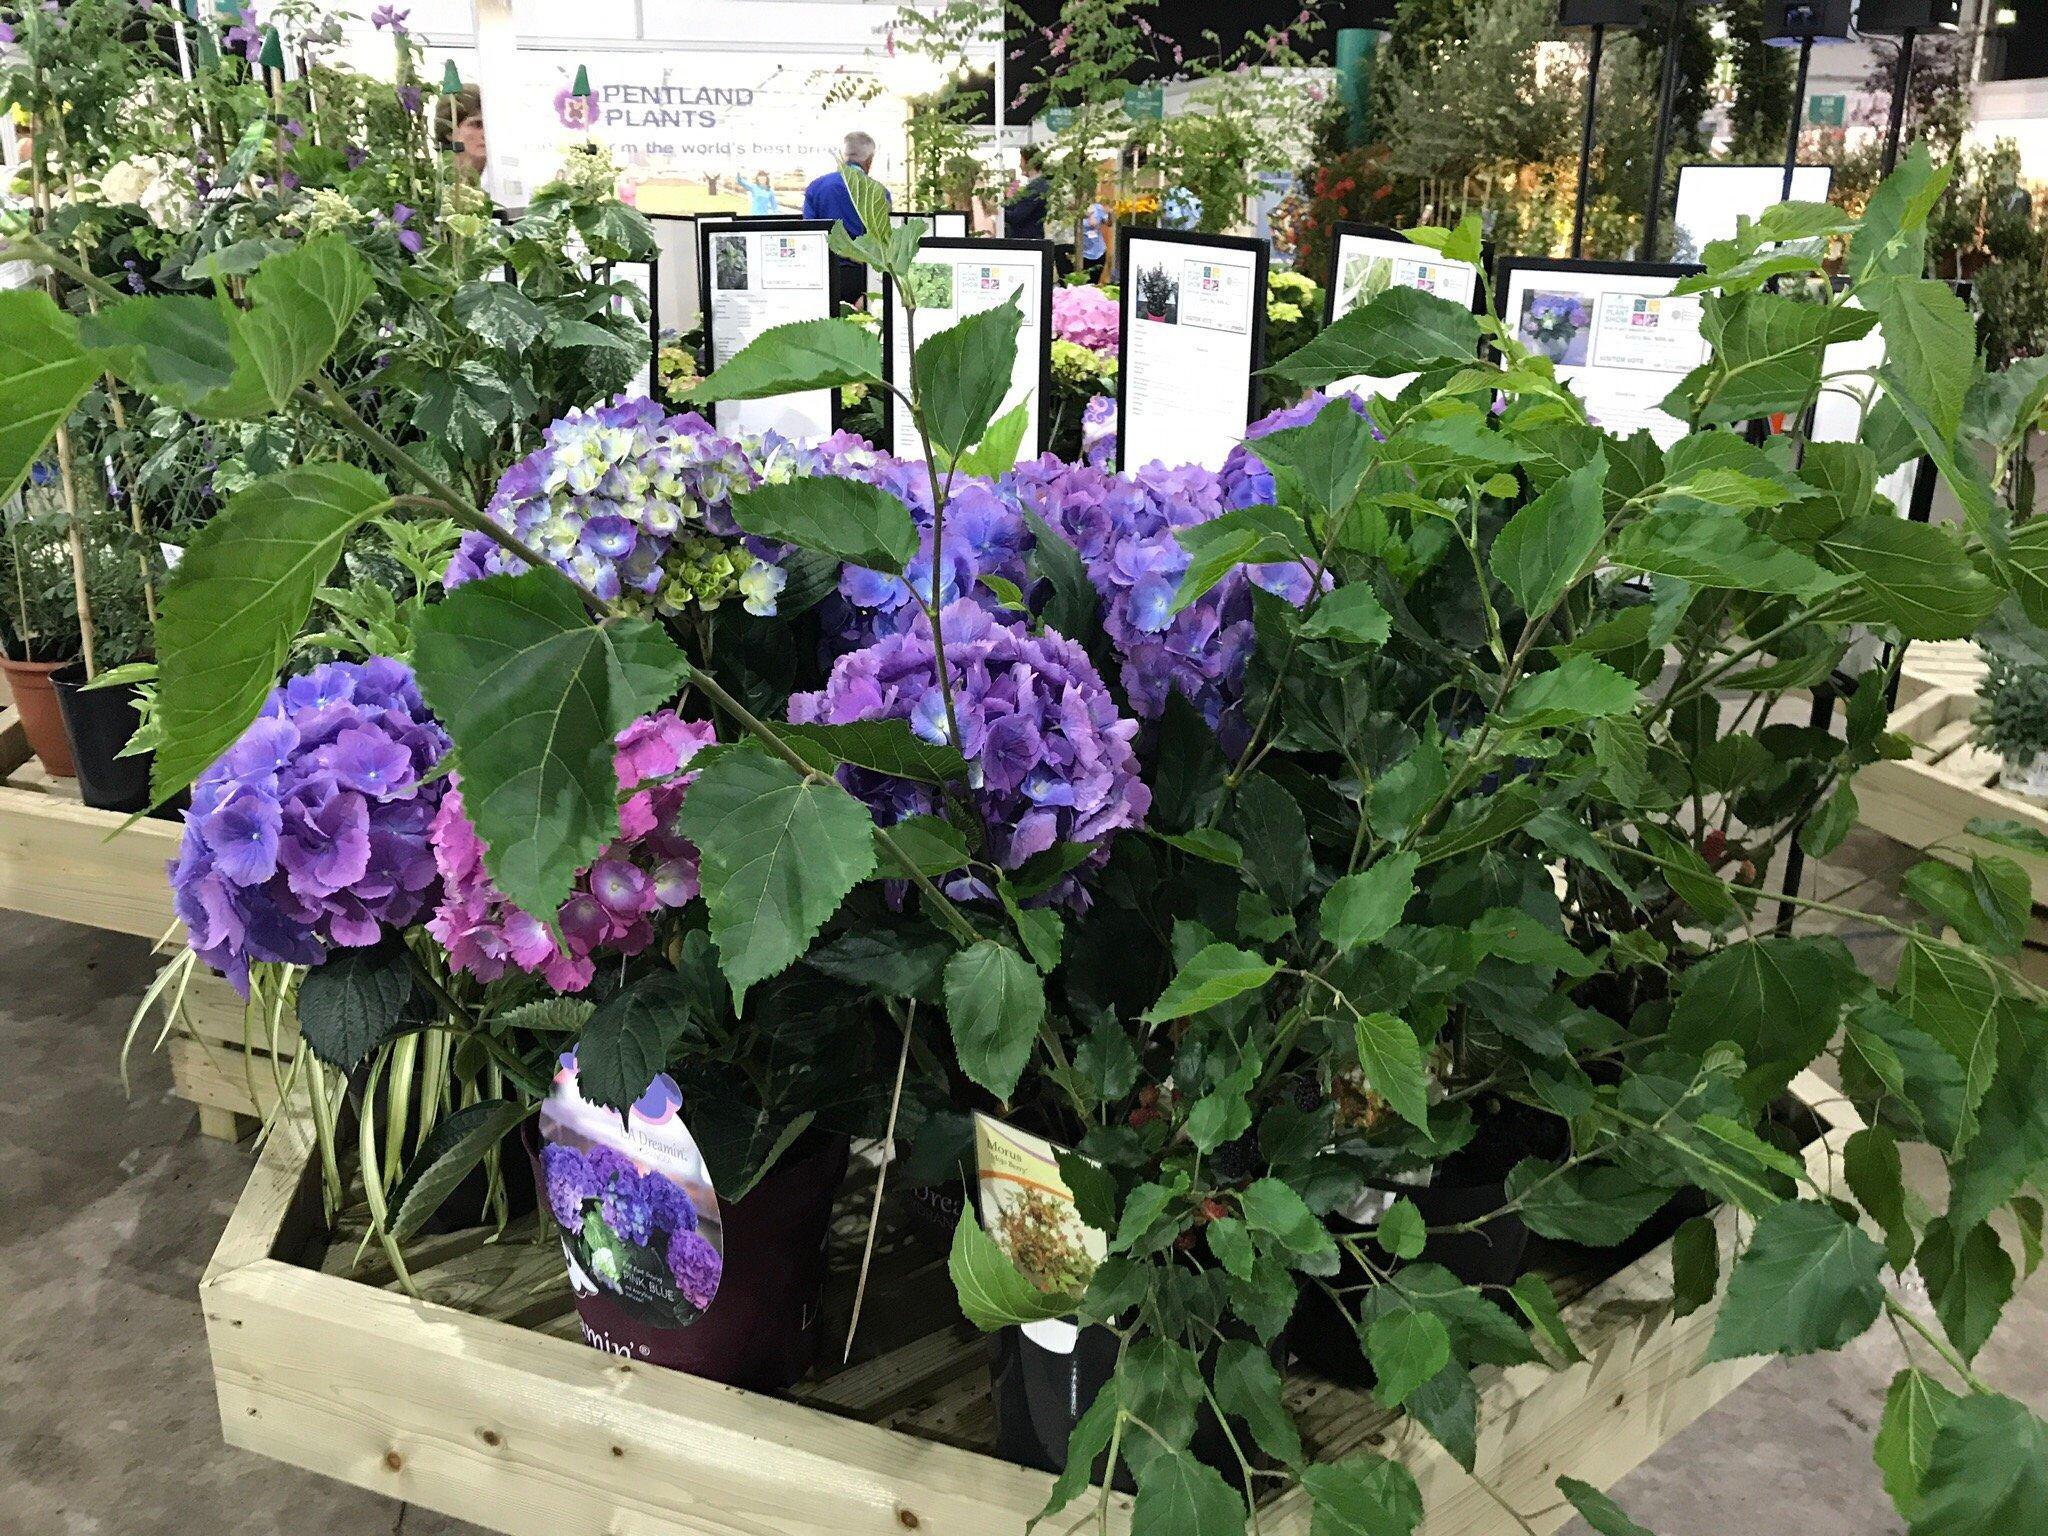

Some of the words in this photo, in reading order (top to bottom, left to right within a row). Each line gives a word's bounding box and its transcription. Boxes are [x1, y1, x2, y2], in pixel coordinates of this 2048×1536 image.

[602, 84, 755, 106] PENTLAND
[605, 108, 717, 128] PLANTS
[645, 142, 675, 155] the
[681, 142, 746, 155] world's
[752, 143, 792, 154] best
[986, 1138, 1023, 1163] Morus
[648, 1280, 675, 1303] BLUE
